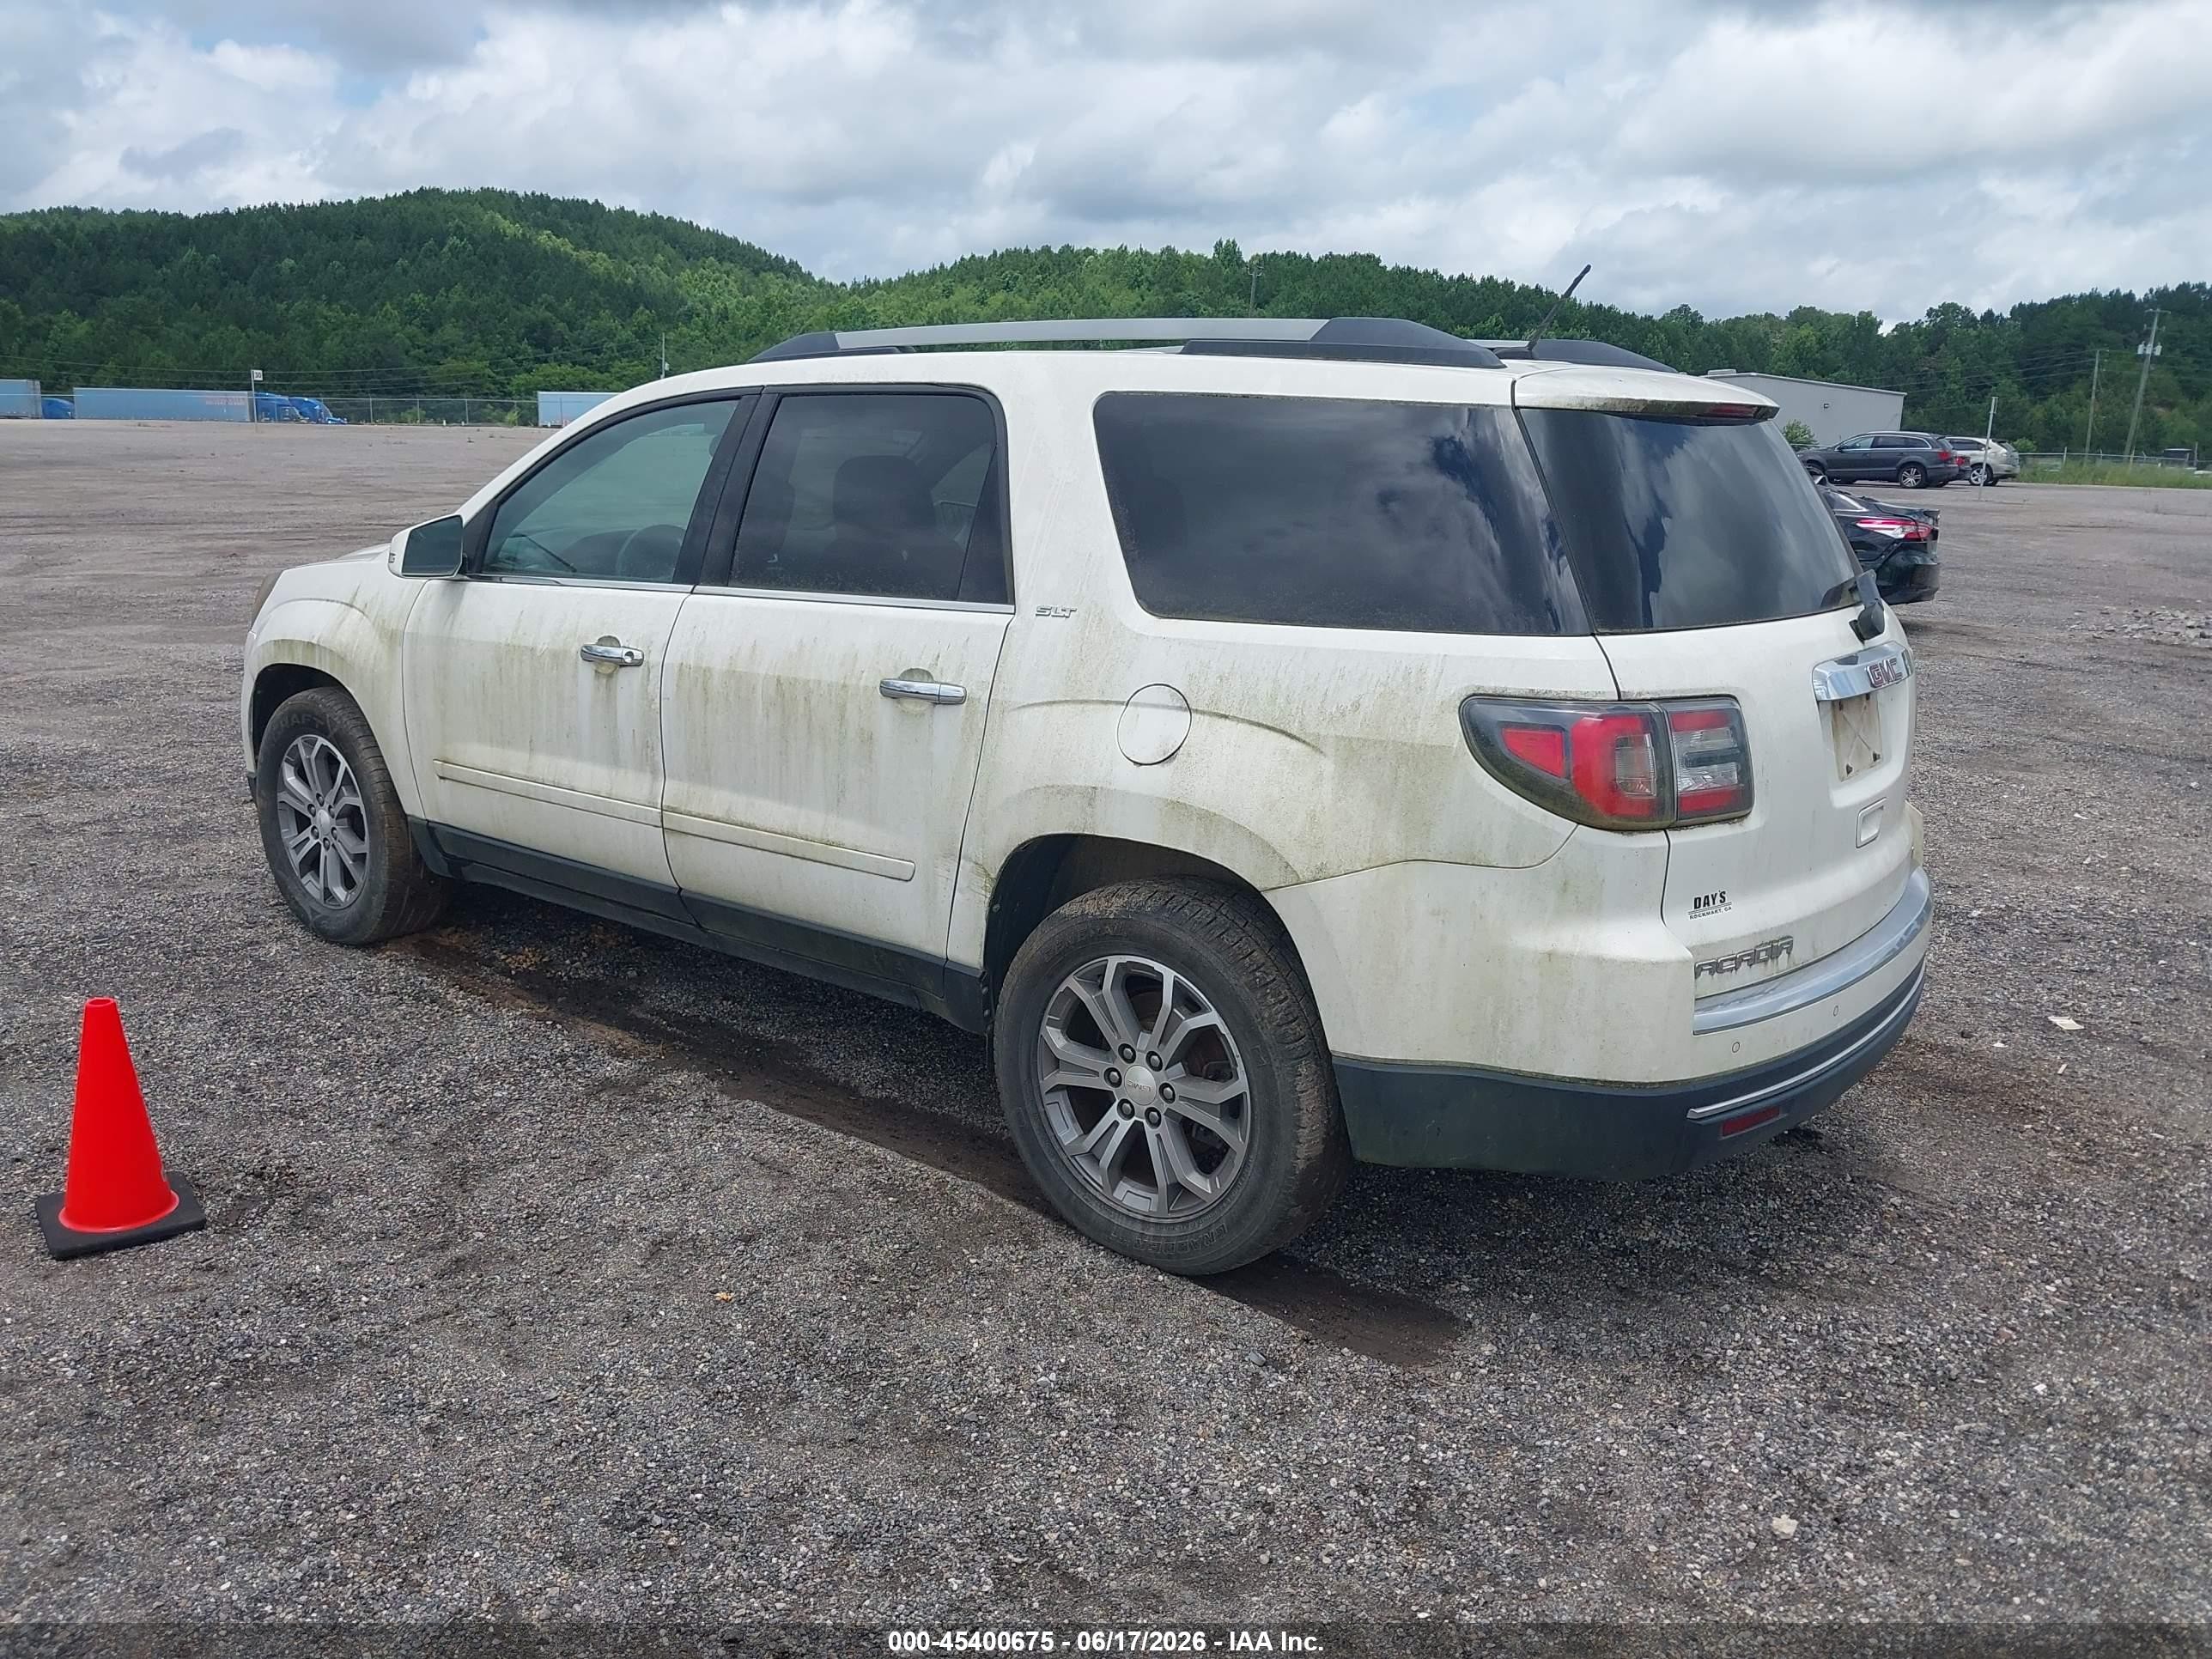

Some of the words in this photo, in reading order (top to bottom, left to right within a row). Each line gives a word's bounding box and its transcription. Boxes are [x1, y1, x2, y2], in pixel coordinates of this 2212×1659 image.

[1035, 605, 1078, 618] SLT
[1866, 657, 1904, 688] GMC
[1693, 890, 1726, 910] DAY'S
[1694, 935, 1794, 980] ACADIA
[1126, 1079, 1152, 1092] GMC
